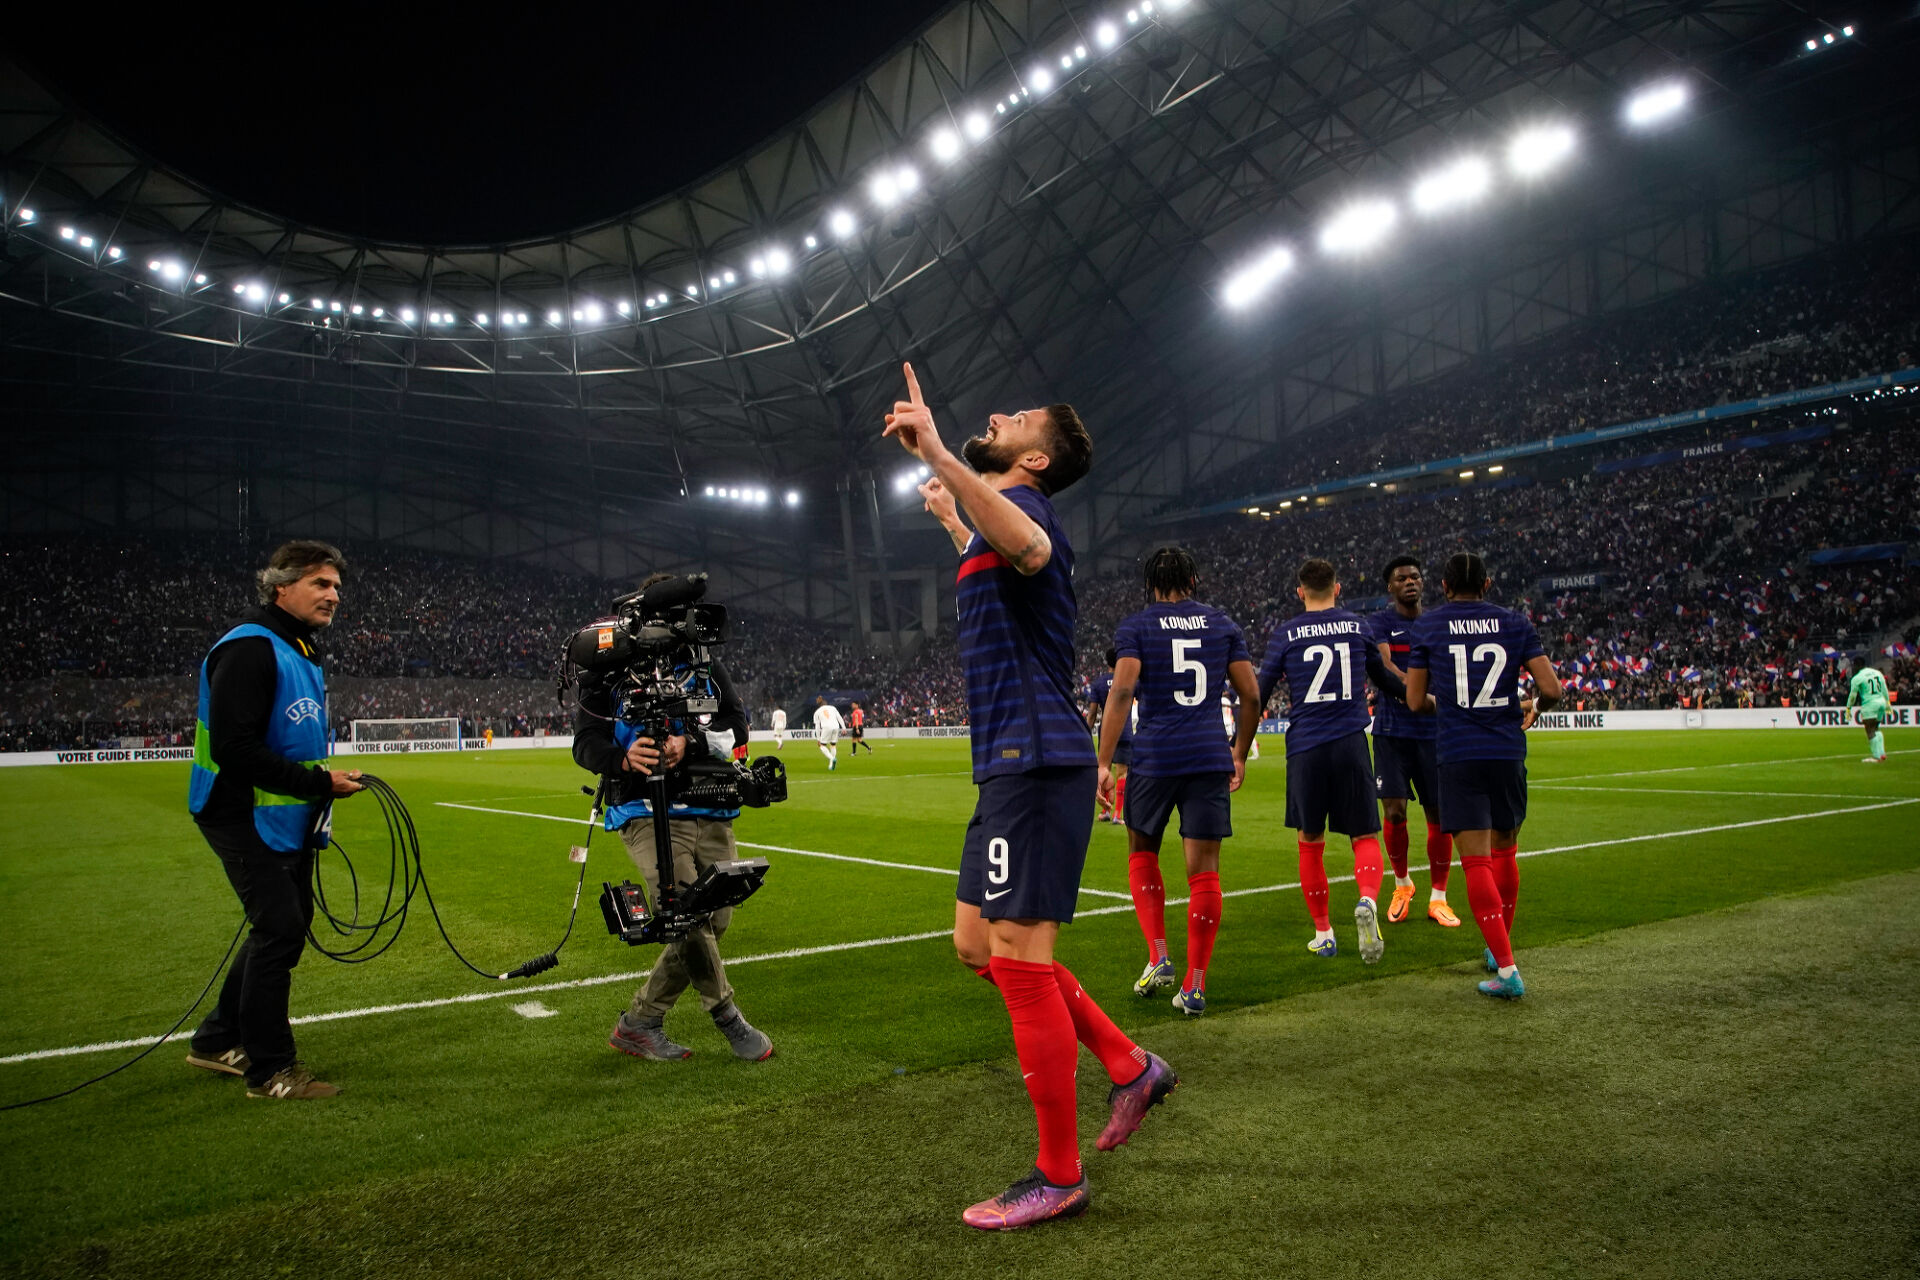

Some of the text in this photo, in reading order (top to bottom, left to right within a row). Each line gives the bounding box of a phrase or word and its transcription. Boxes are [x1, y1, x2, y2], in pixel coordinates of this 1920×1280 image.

[1682, 443, 1724, 458] FRANCE
[1552, 575, 1596, 590] FRANCE
[1160, 615, 1209, 630] KOUNDE
[1448, 618, 1500, 635] NKUNKU
[1287, 621, 1361, 642] L.HERNANDEZ
[1172, 638, 1208, 706] 5
[1303, 642, 1352, 703] 21
[1448, 643, 1509, 708] 12
[1573, 713, 1604, 728] NIKE
[791, 730, 812, 739] VOTRE
[465, 739, 486, 749] NIKE
[57, 752, 94, 763] VOTRE
[97, 750, 131, 762] GUIDE
[988, 837, 1009, 884] 9
